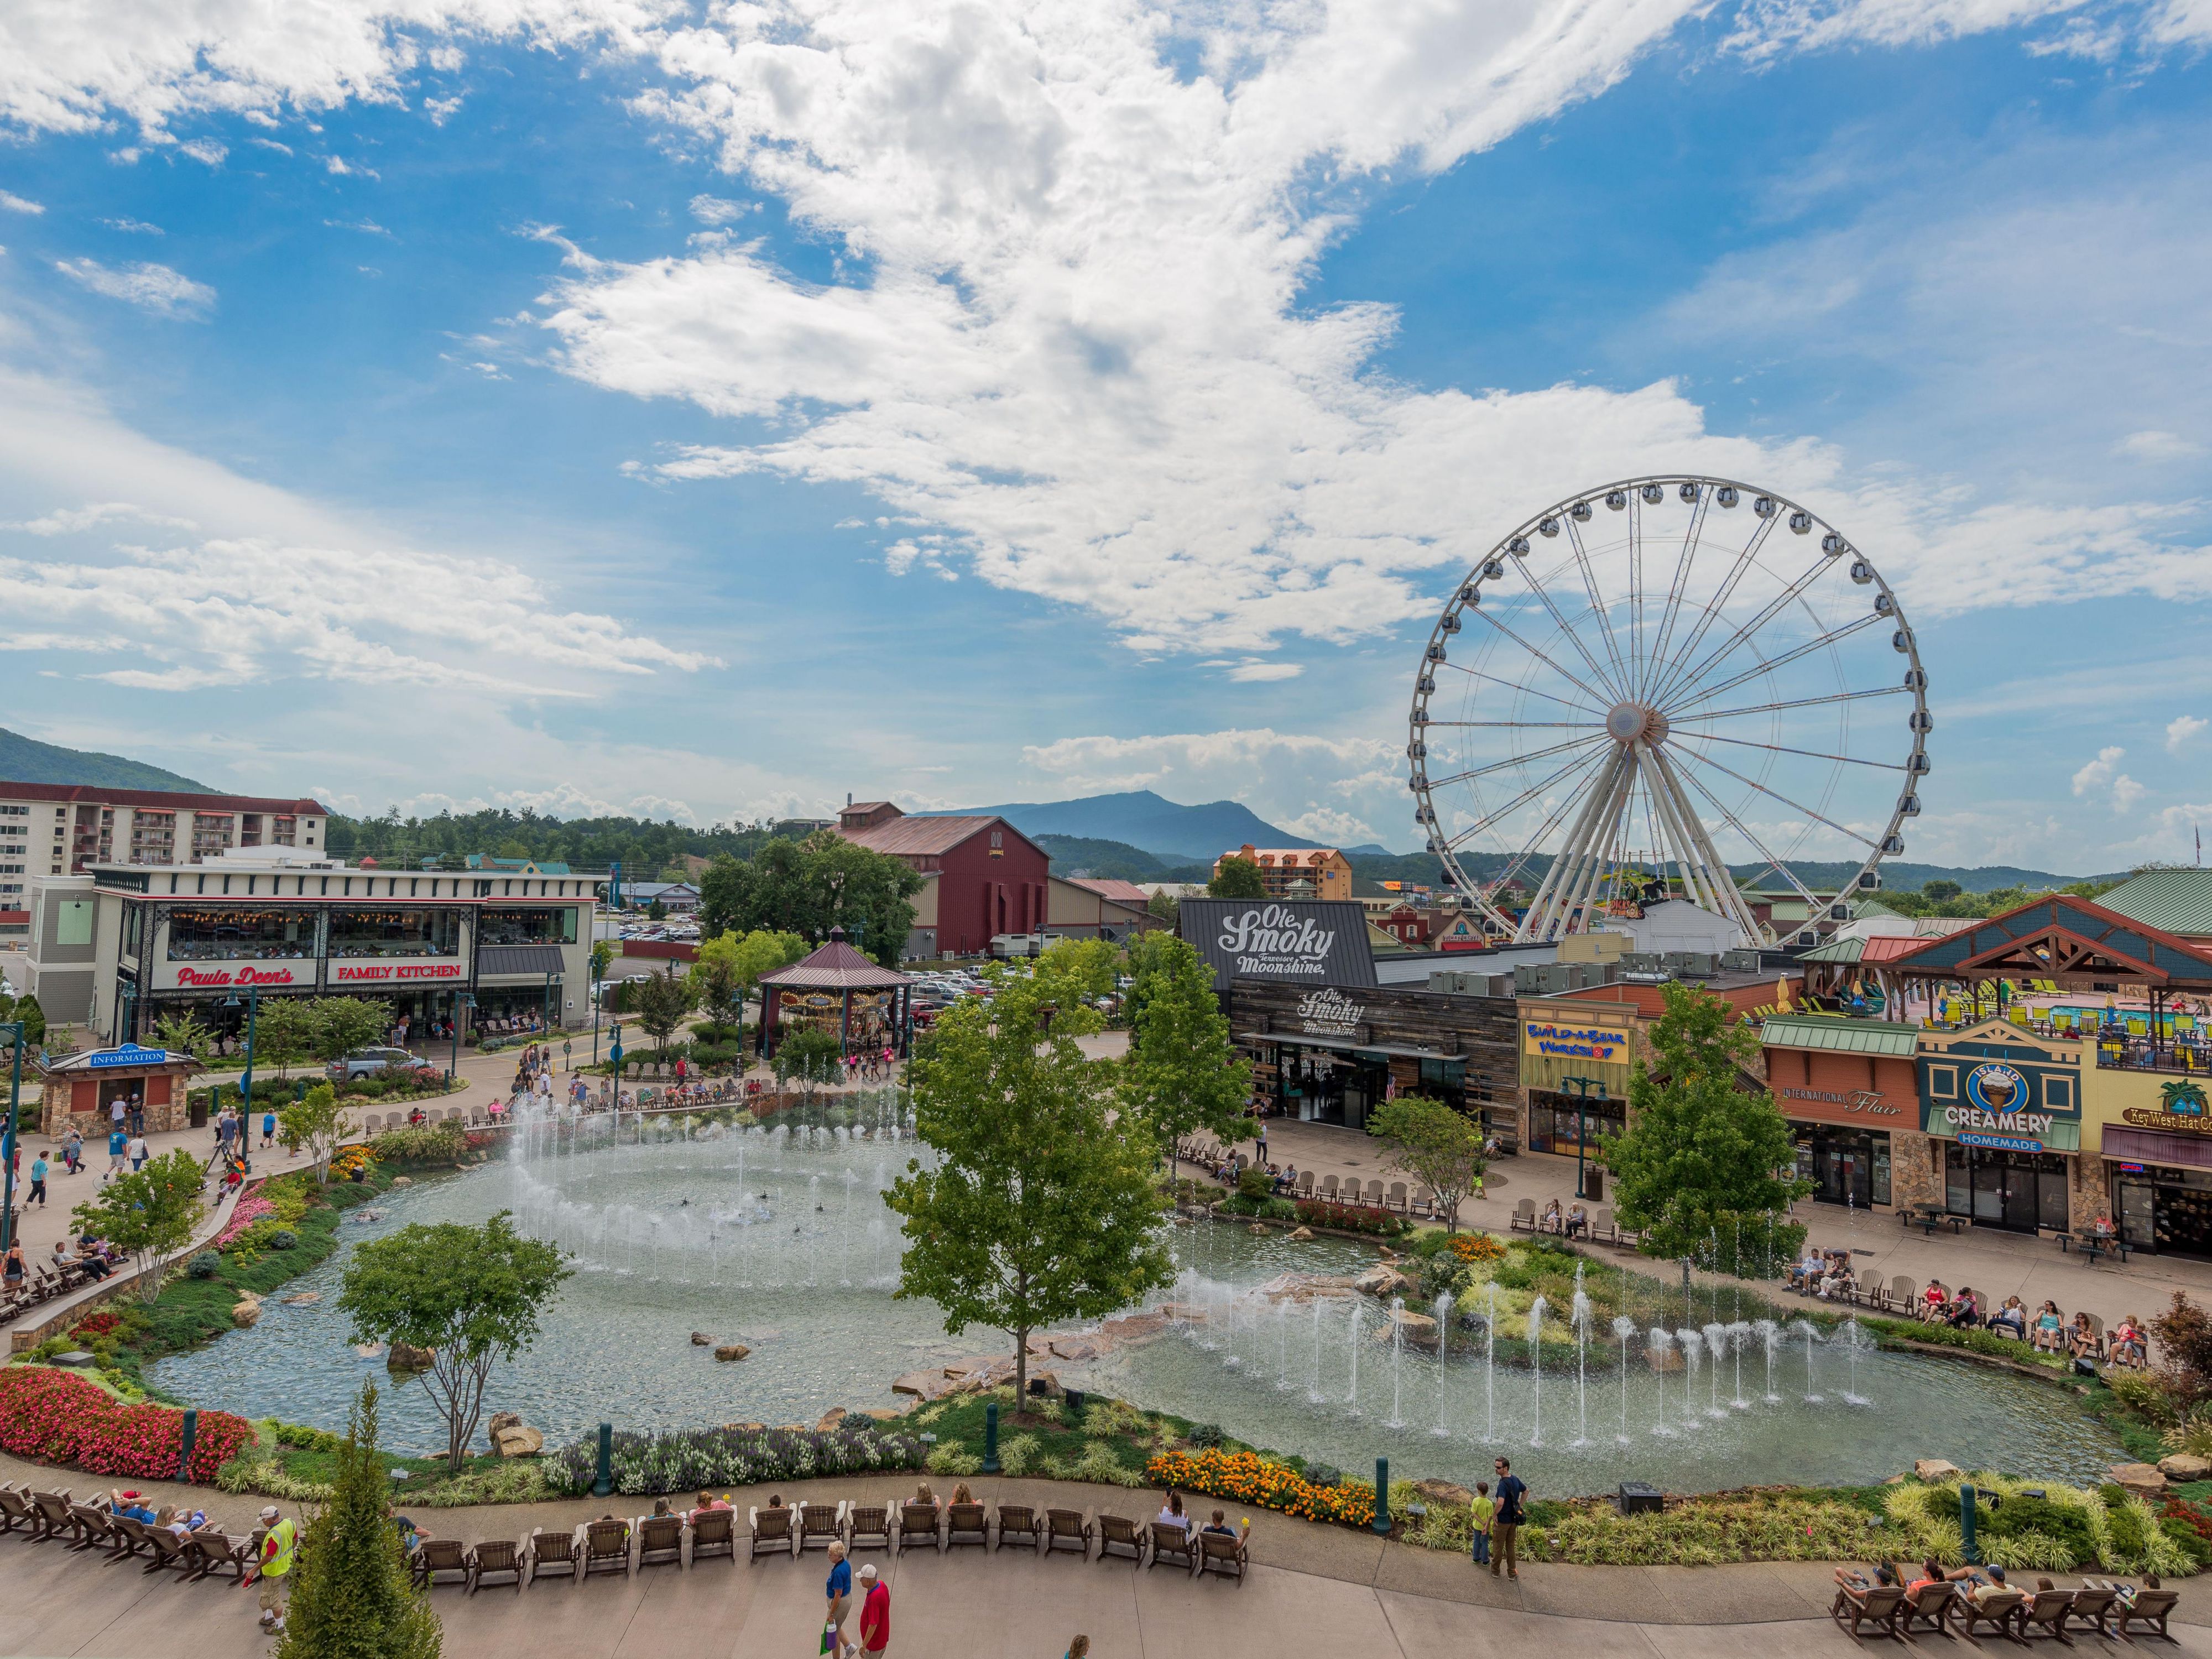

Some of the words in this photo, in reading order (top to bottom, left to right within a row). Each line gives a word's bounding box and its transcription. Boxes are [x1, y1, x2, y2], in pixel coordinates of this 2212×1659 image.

[1262, 904, 1302, 930] Ole
[1218, 910, 1334, 961] Smoky
[1259, 953, 1294, 962] Tennessee
[178, 967, 232, 986] Paula
[234, 966, 294, 985] Deen's
[338, 967, 394, 979] FAMILY
[396, 965, 461, 978] KITCHEN
[1323, 988, 1345, 1005] Ole
[1297, 992, 1366, 1026] Smoky
[93, 1053, 163, 1064] INFORMATION
[1539, 1040, 1614, 1059] WORKSHOP
[1975, 1065, 2020, 1081] ISLAND
[1783, 1088, 1848, 1104] INTERNATIONAL
[1844, 1089, 1901, 1115] Flair
[1945, 1106, 2053, 1133] CREAMERY
[2131, 1109, 2149, 1126] Key
[2149, 1111, 2176, 1127] West
[2178, 1114, 2199, 1129] Hat
[1962, 1134, 2037, 1151] HOMEMADE
